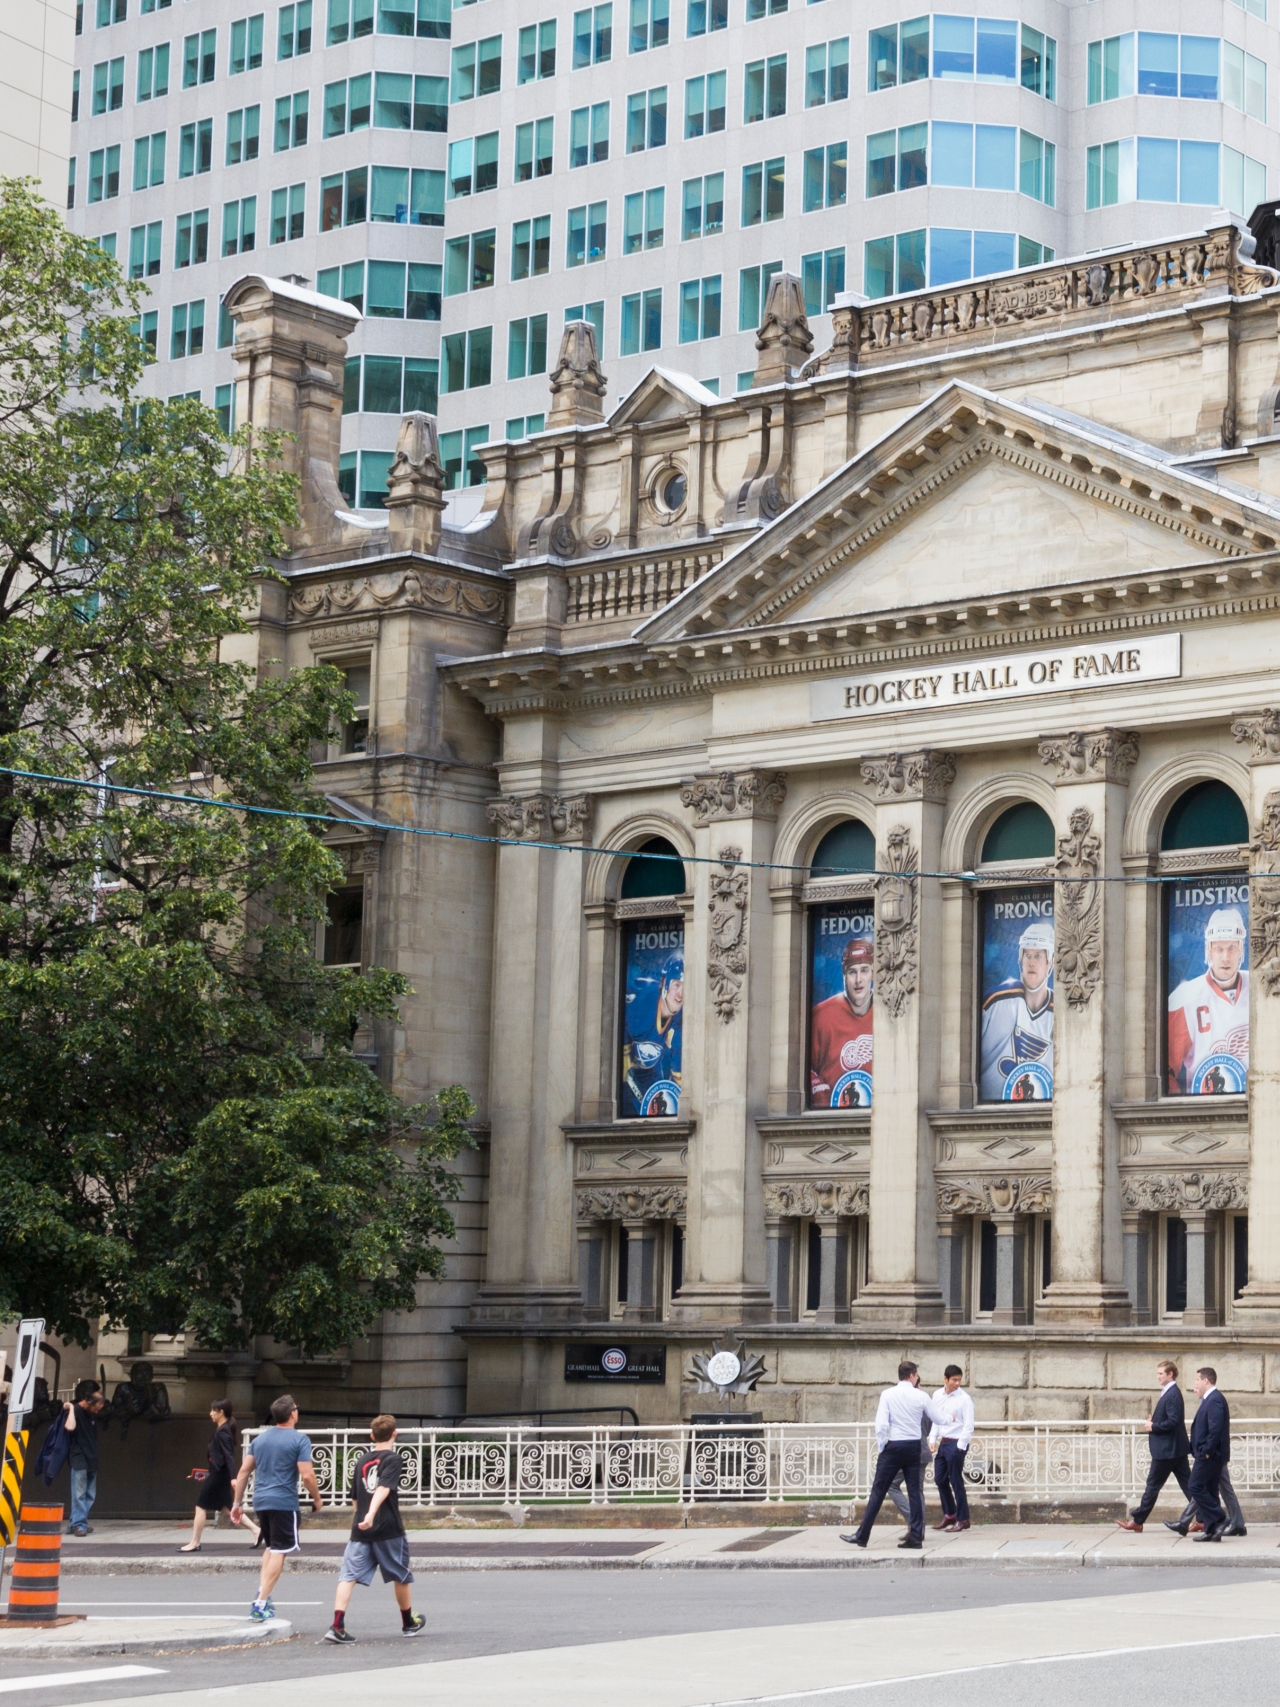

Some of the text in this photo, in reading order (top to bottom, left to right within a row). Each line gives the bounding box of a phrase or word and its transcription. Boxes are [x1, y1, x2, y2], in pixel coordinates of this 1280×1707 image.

[843, 648, 1140, 708] HOCKEY HALL OF FAME
[1175, 885, 1249, 908] LIDSTRO
[994, 900, 1053, 920] PRONG
[821, 915, 875, 935] FEDOR
[1196, 1005, 1211, 1033] C
[1198, 1059, 1214, 1078] HOCKEY
[1232, 1062, 1244, 1077] FAME
[627, 1364, 645, 1372] GREAT
